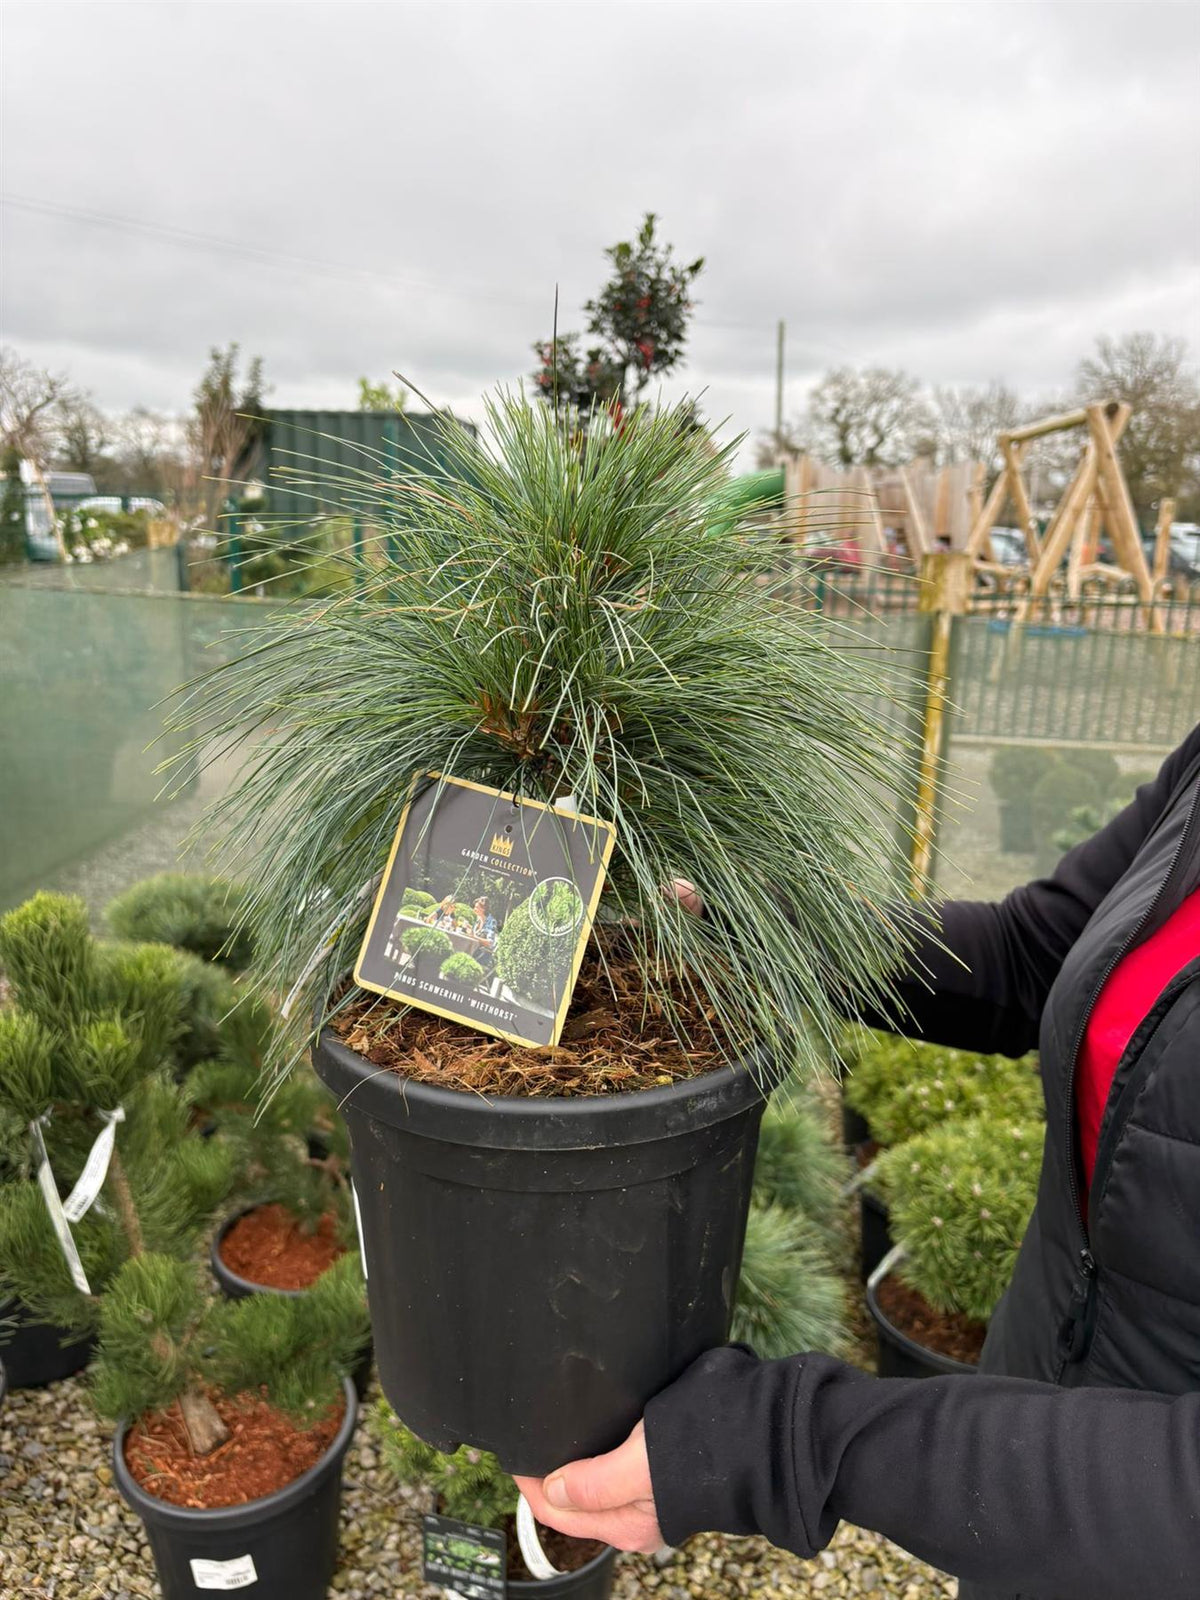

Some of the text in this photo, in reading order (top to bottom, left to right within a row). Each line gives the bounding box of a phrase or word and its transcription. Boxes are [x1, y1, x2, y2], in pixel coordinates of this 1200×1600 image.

[461, 848, 489, 863] GARDEN
[492, 845, 510, 855] KINGS
[418, 980, 465, 1004] SCHWERINII
